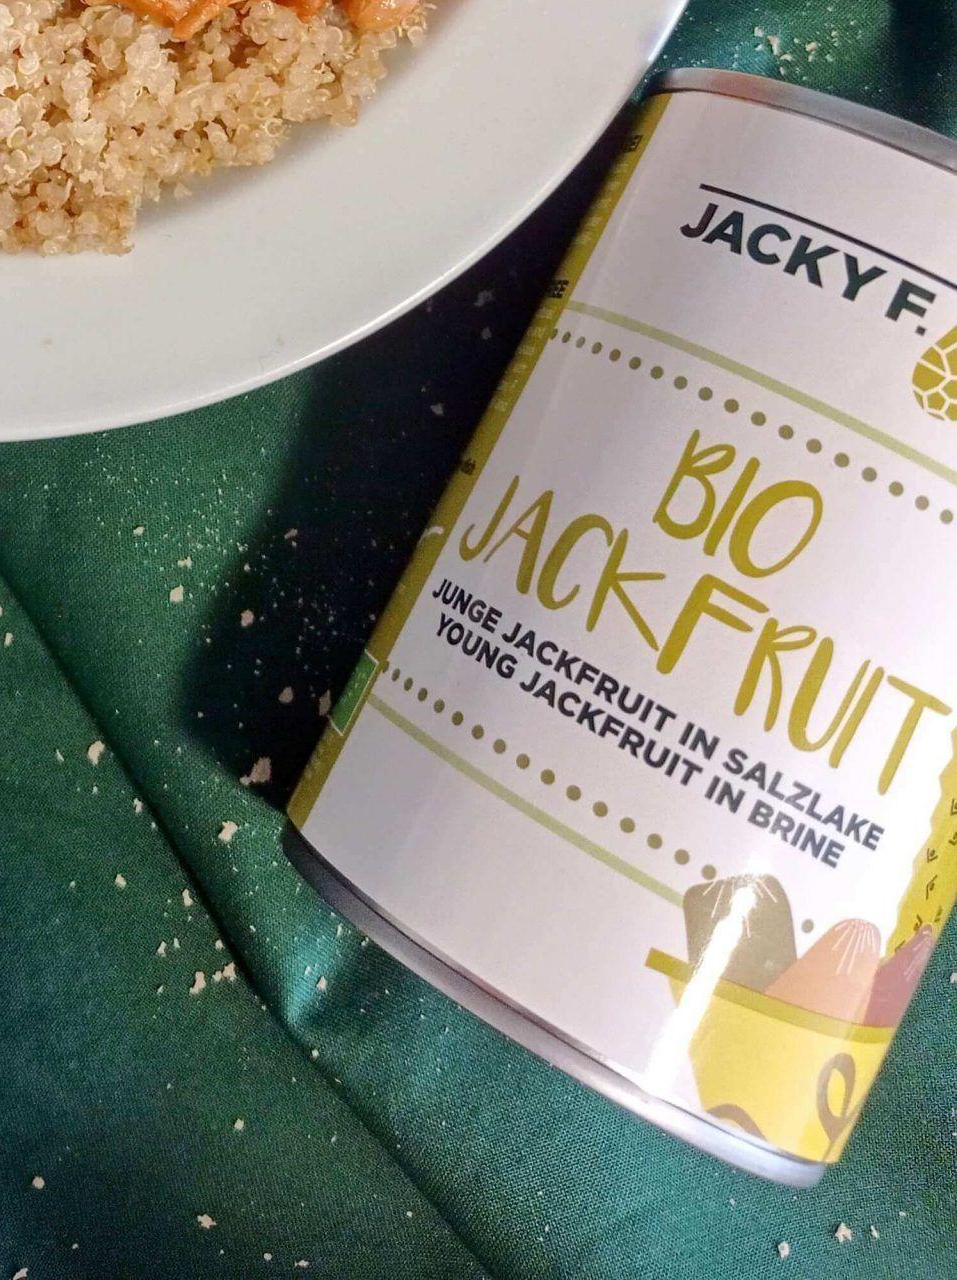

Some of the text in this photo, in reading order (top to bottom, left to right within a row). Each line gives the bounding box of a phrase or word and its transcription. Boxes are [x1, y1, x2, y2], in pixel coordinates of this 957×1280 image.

[679, 202, 888, 302] JACKY
[884, 278, 937, 337] F.
[652, 428, 824, 580] BIO
[431, 577, 885, 852] JUNGE JACKFRUIT IN SALZLAKE
[435, 610, 846, 869] YOUNG JACKFRUIT IN BRINE
[458, 475, 953, 795] JACKFRUIT
